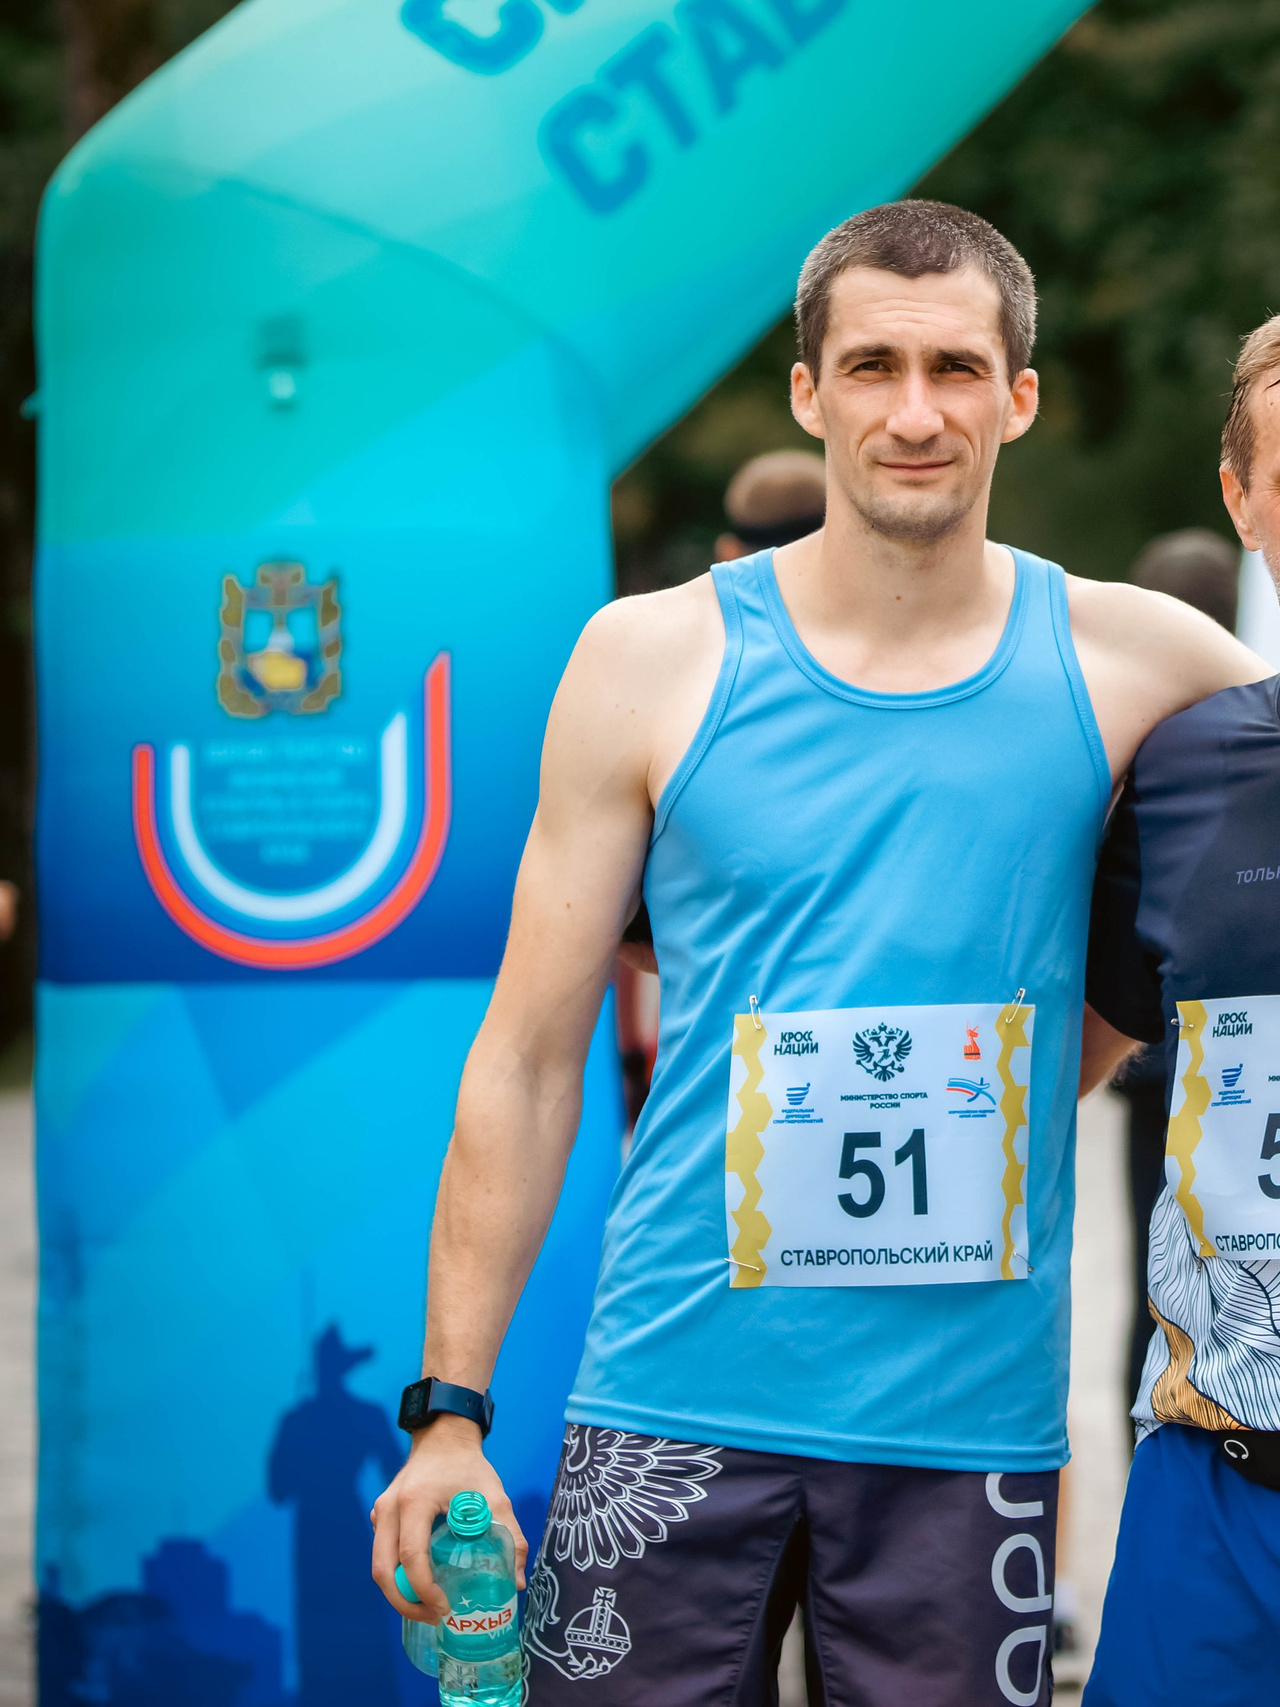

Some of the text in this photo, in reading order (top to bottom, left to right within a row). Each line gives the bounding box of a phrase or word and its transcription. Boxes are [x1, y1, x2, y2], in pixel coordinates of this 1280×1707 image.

[1218, 1011, 1248, 1025] КРОСС
[781, 1031, 813, 1043] КРОСС
[1212, 1023, 1253, 1038] НАЦИИ
[774, 1042, 819, 1056] НАЦИИ
[840, 1092, 928, 1102] МИНИСТЕРСТВО СПОРТА
[870, 1102, 901, 1110] РОССИИ
[837, 1128, 929, 1219] 51
[780, 1240, 993, 1267] СТАВРОПОЛЬСКИЙ КРАЙ
[446, 1608, 512, 1632] АРХЫЗ
